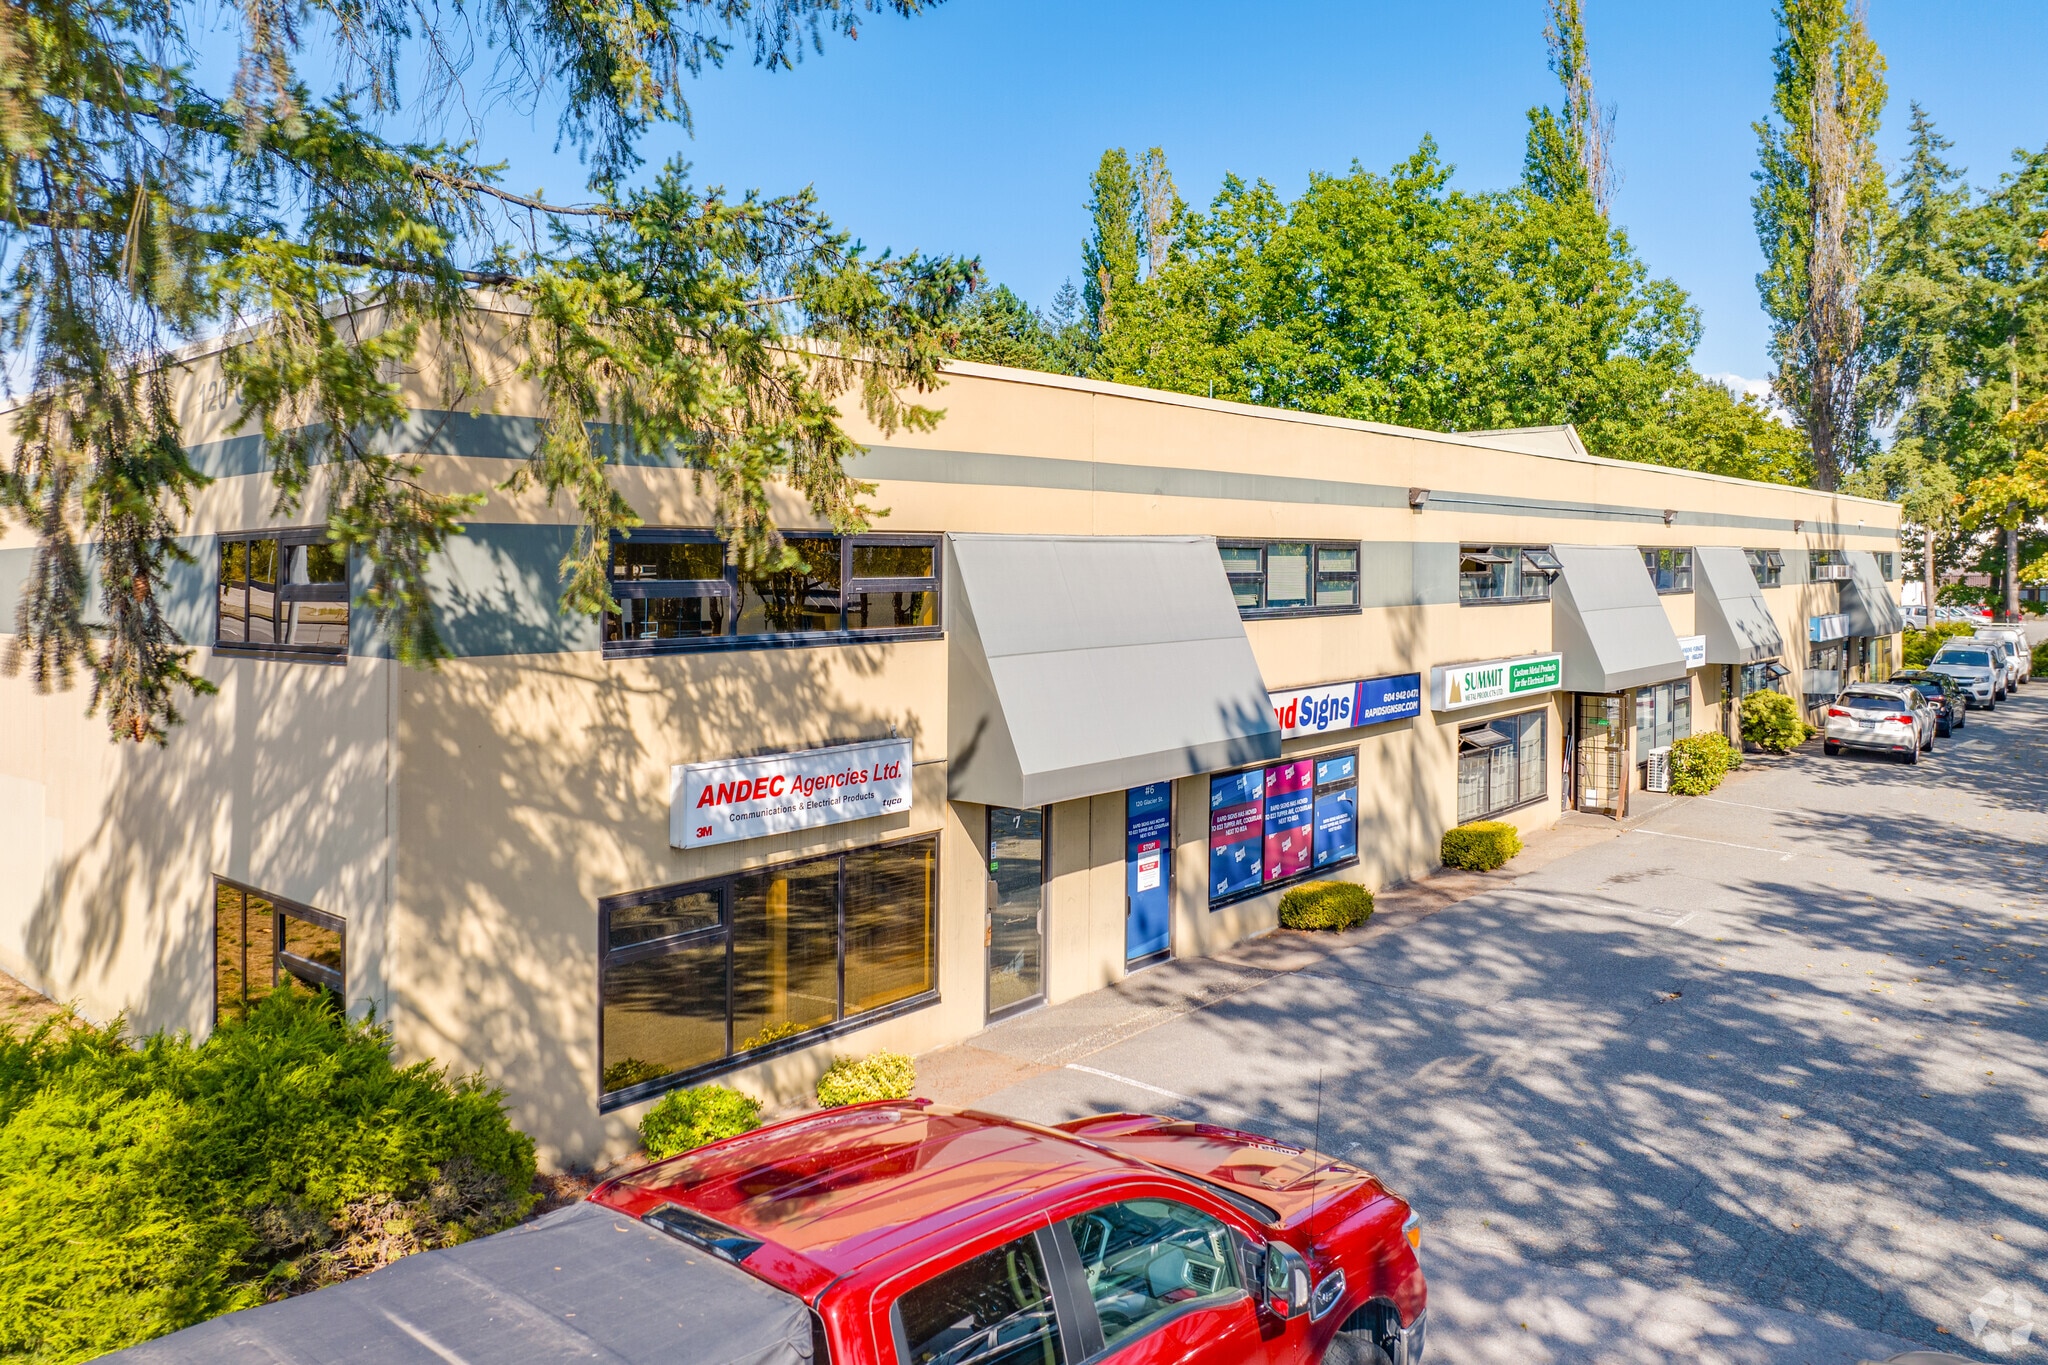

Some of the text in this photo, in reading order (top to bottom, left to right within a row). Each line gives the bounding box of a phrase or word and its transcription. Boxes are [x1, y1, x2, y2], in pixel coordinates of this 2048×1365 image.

[199, 379, 228, 414] 120
[1513, 664, 1557, 677] Custom Metal Products
[1465, 668, 1503, 691] SUMMIT
[1383, 692, 1395, 702] 604
[1299, 695, 1350, 731] Signs
[1364, 701, 1418, 719] RAPIDSIGNSBC.COM
[696, 761, 902, 809] ANDEC Agencies Ltd.
[1145, 785, 1155, 795] #6
[729, 792, 875, 822] Communications & Electrical Products
[882, 797, 903, 808] tyco
[1143, 798, 1158, 806] Glacier
[696, 826, 713, 838] 3M
[1142, 842, 1156, 852] STOP!
